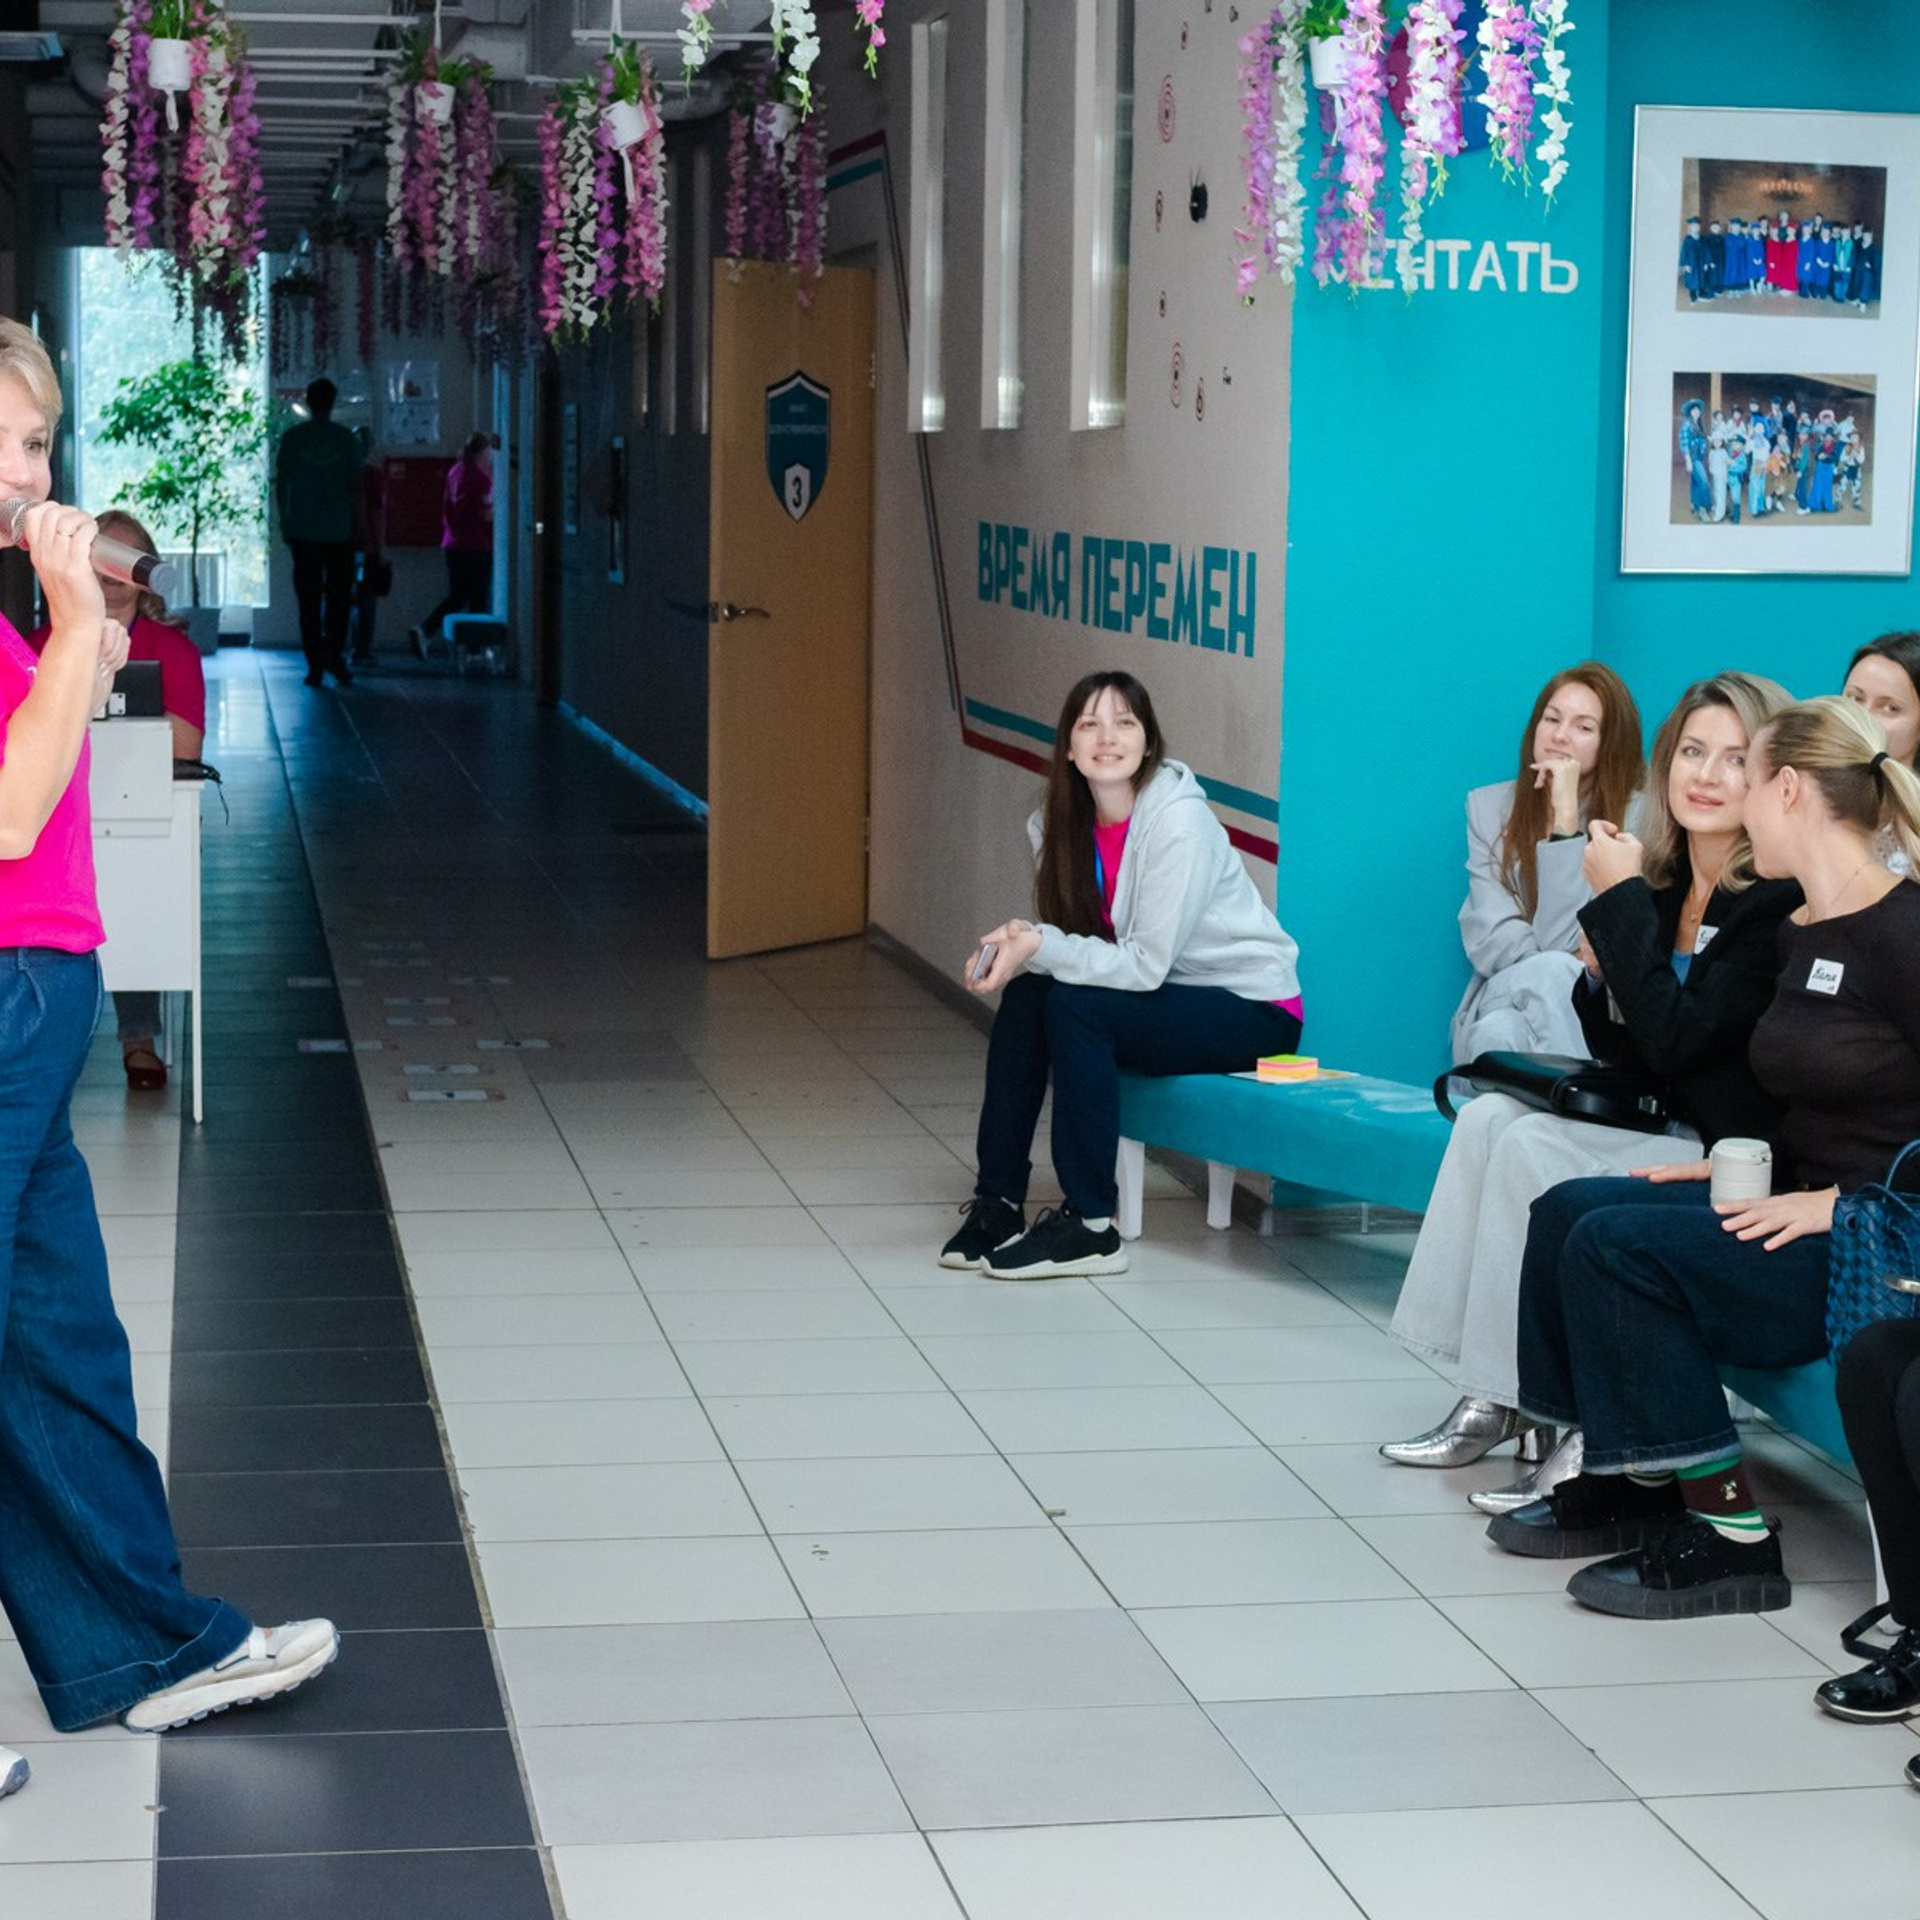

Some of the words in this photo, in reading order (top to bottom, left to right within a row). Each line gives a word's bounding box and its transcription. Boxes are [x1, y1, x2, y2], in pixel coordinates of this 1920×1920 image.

[792, 476, 802, 508] 3
[978, 521, 1071, 621] ВРЕМЯ
[1081, 535, 1257, 658] ПЕРЕМЕН
